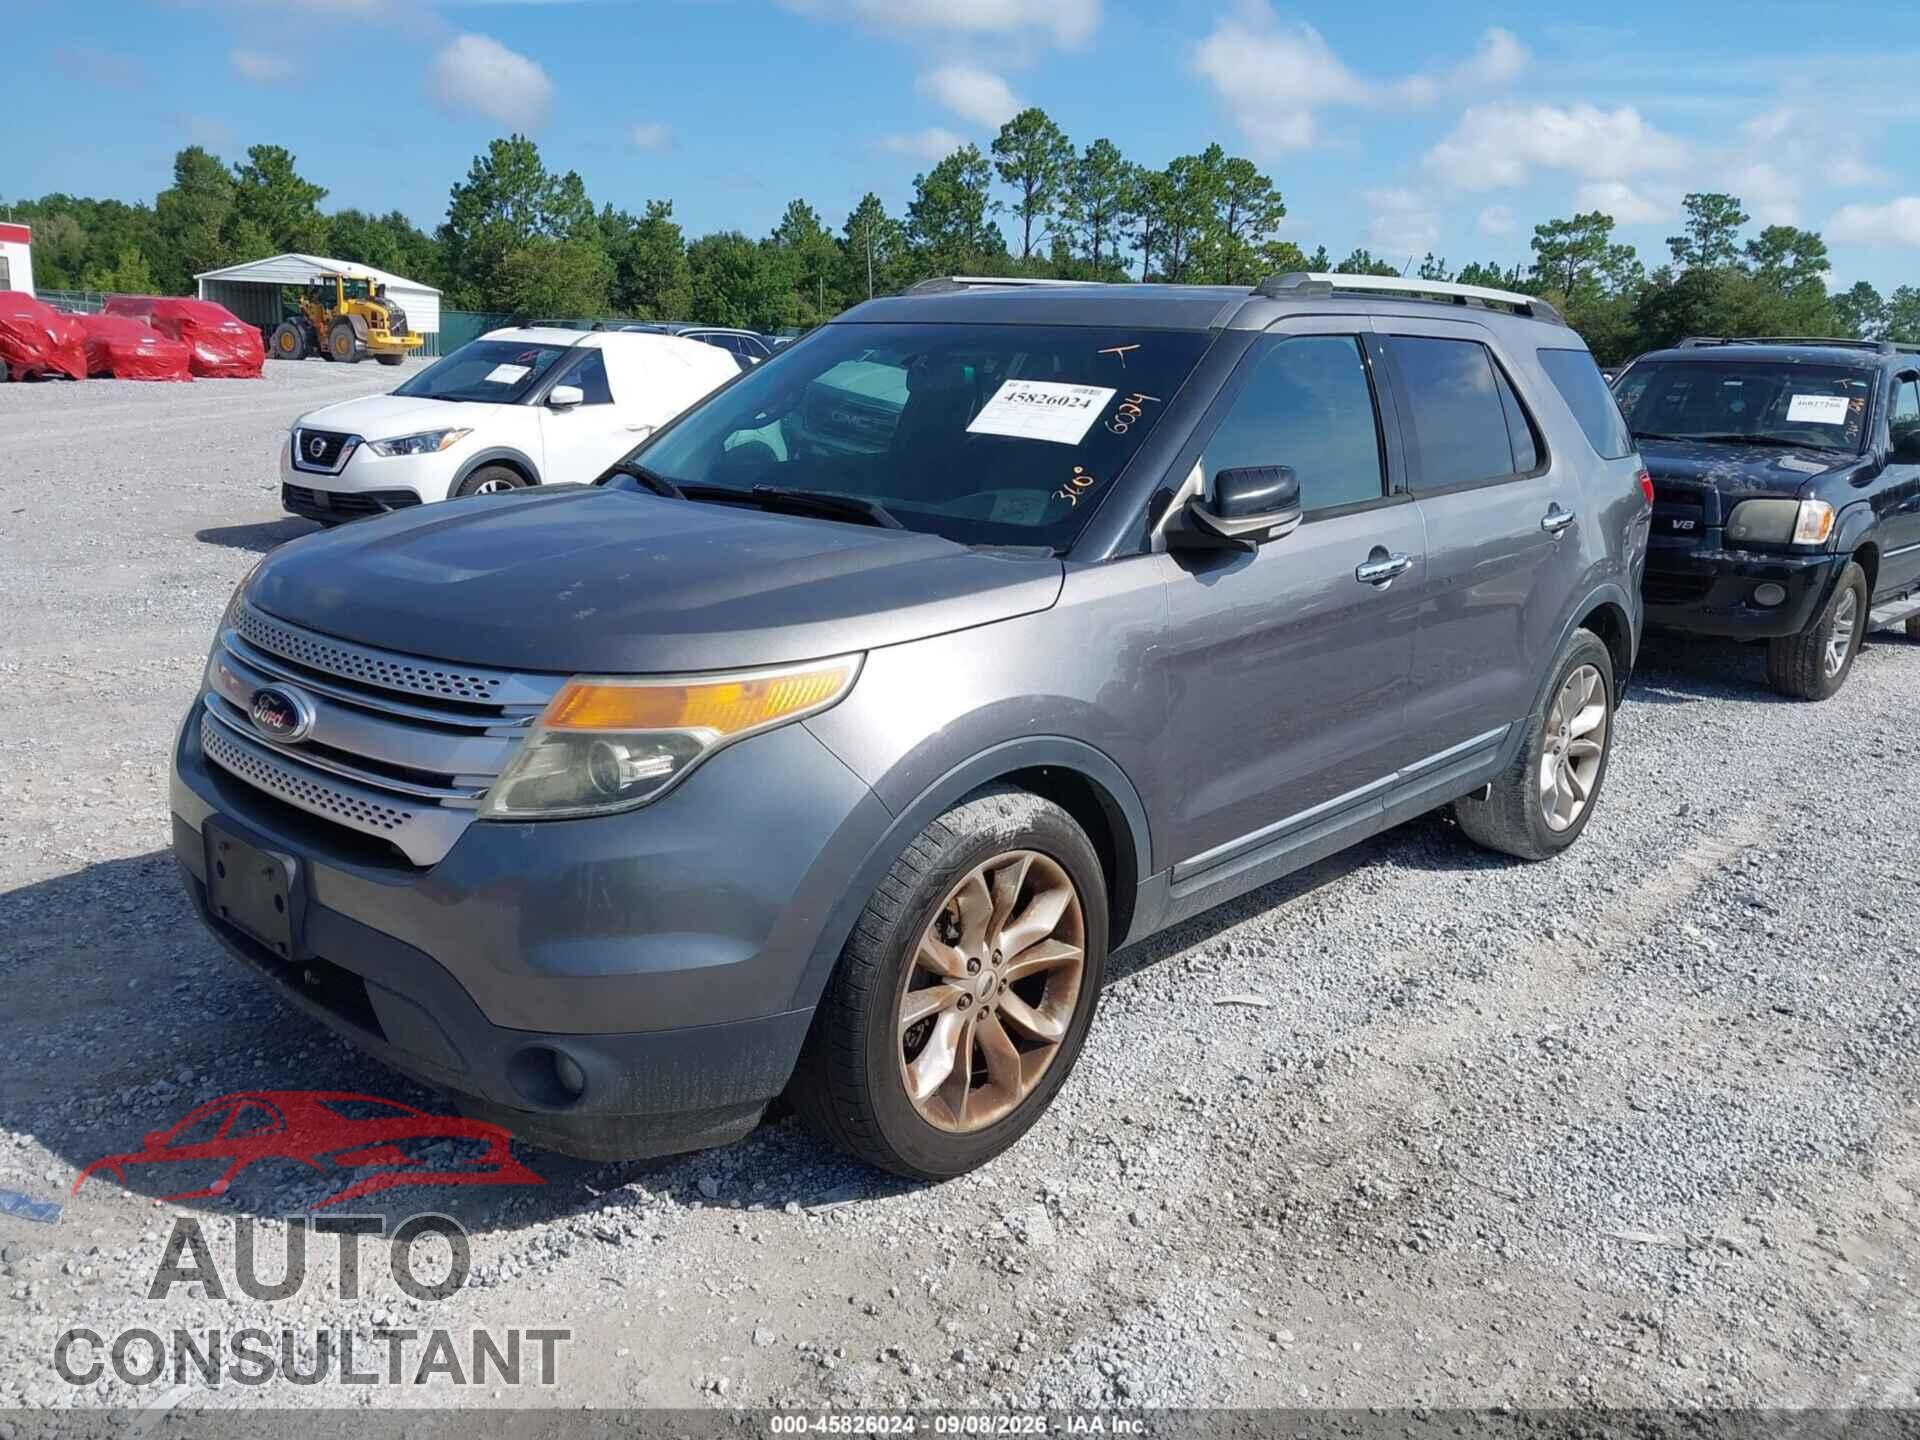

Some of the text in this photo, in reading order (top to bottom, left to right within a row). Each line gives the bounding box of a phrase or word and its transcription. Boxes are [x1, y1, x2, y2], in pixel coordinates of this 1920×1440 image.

[1003, 390, 1092, 409] 45826024
[1672, 519, 1695, 529] V8
[254, 694, 286, 728] Ford
